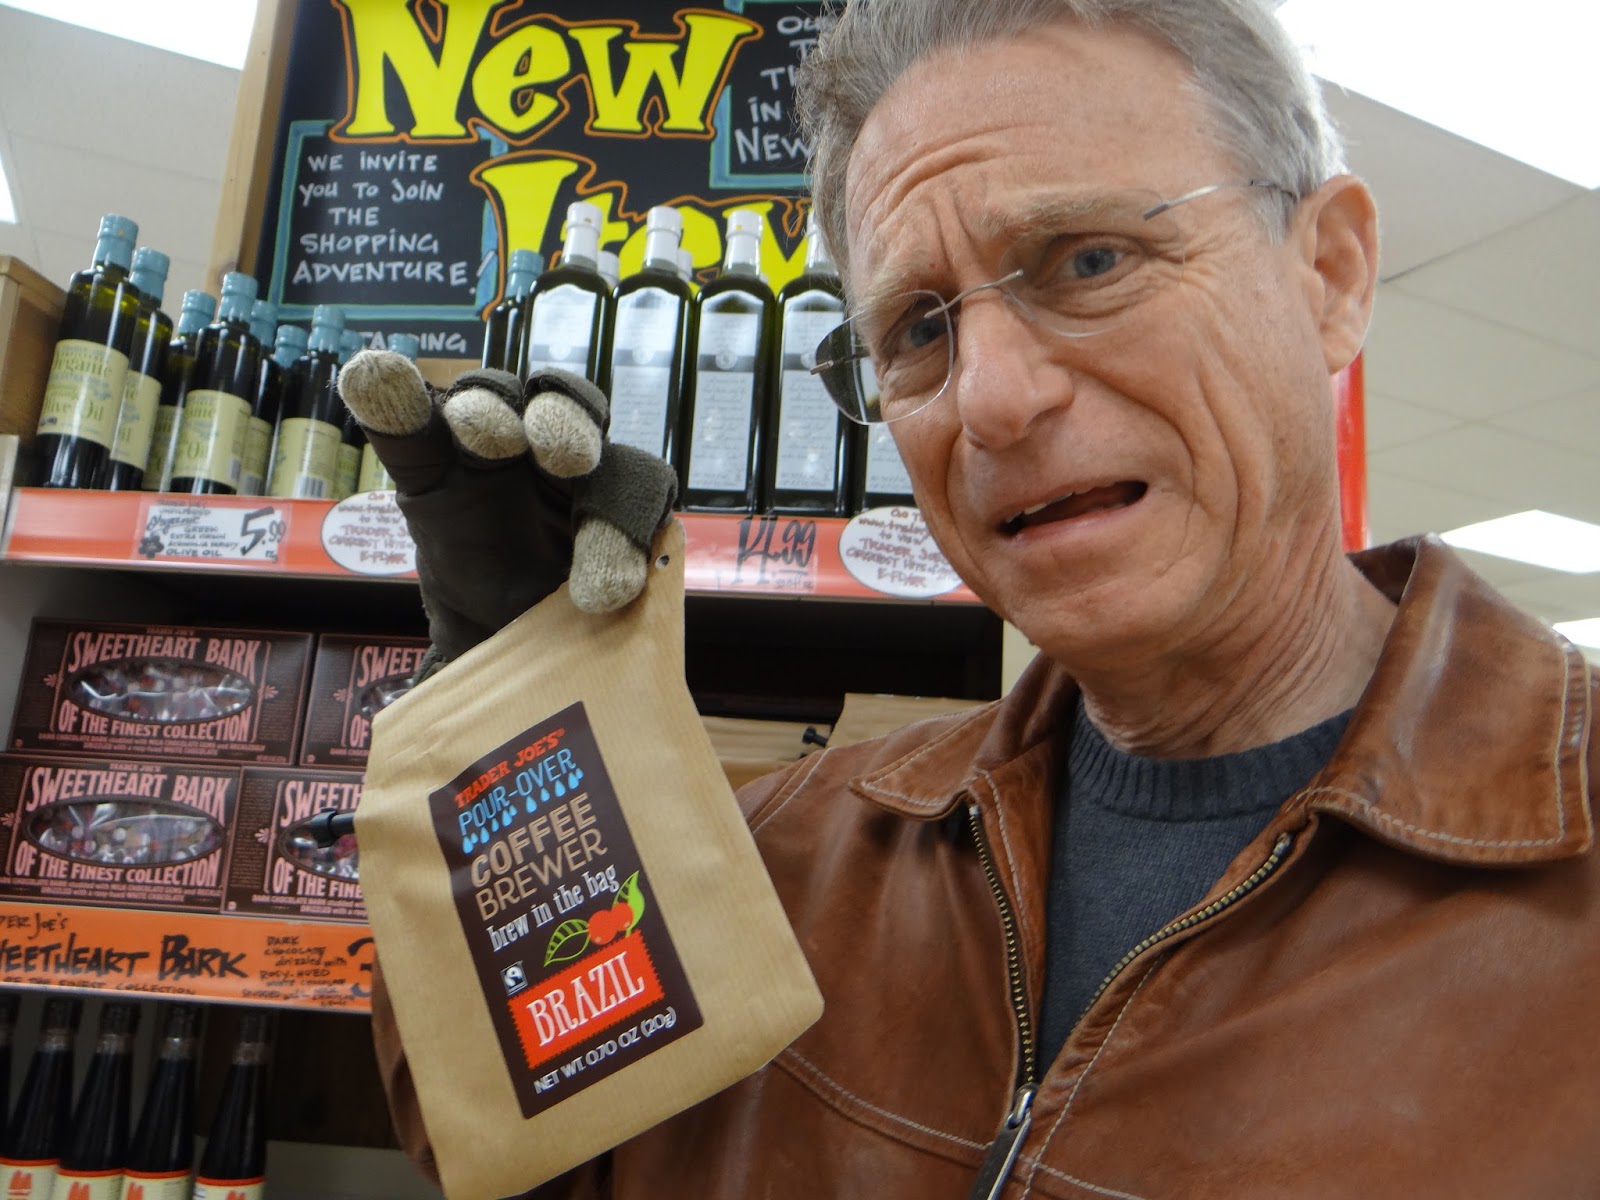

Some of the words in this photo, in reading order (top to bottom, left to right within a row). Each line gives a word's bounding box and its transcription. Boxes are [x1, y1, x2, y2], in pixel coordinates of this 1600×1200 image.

[346, 0, 755, 138] New
[747, 96, 782, 124] IN
[308, 154, 343, 172] WE
[359, 150, 439, 172] INVITE
[391, 178, 444, 203] JOIN
[328, 206, 381, 226] THE
[300, 228, 439, 254] SHOPPING
[166, 548, 199, 557] OLIVE
[202, 549, 223, 558] OIL
[68, 632, 201, 672] SWEETHEART
[205, 638, 262, 684] BARK
[357, 646, 427, 688] SWEET
[58, 700, 79, 733] OF
[81, 713, 108, 734] THE
[111, 719, 161, 738] FINEST
[163, 705, 253, 742] COLLECTION
[349, 714, 370, 747] OF
[25, 766, 167, 812] SWEETHEART
[171, 774, 232, 827] BARK
[281, 780, 364, 827] SWEETH
[454, 760, 512, 809] TRADER
[458, 748, 577, 836] POUR-OVER
[15, 840, 38, 876] OF
[38, 854, 69, 879] THE
[71, 863, 123, 882] FINEST
[126, 848, 222, 887] COLLECTION
[470, 792, 597, 888] COFFEE
[272, 857, 294, 895] OF
[297, 869, 327, 896] THE
[329, 880, 364, 899] FINE
[475, 828, 608, 922] BREWER
[486, 913, 530, 952] brew
[531, 900, 555, 928] in
[553, 884, 586, 915] the
[582, 864, 620, 900] bag
[0, 932, 149, 978] EETHEART
[158, 934, 248, 981] BARK
[115, 981, 197, 996] COLLECTION
[526, 951, 647, 1047] BRAZIL
[533, 1068, 561, 1095] NET
[617, 1026, 642, 1049] OZ
[640, 1005, 677, 1038] (20g)
